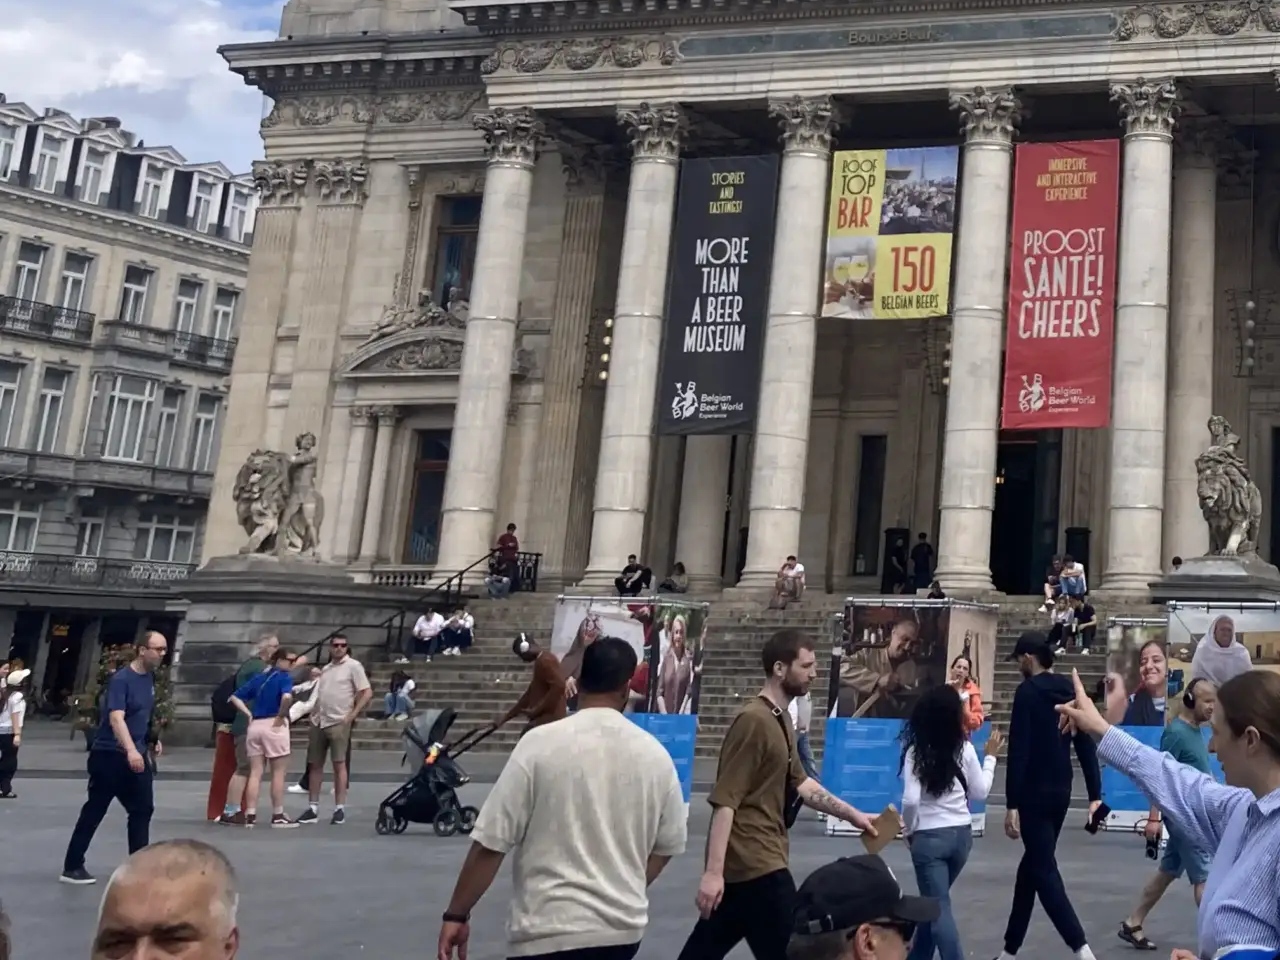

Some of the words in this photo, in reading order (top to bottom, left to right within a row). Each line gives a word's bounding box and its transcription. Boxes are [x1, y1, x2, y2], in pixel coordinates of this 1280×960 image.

[842, 159, 878, 173] ROOF
[1048, 157, 1088, 171] IMMERSIVE
[712, 171, 745, 185] STORIES
[842, 174, 876, 195] TOP
[1037, 174, 1052, 187] AND
[720, 186, 734, 199] AND
[1045, 187, 1088, 201] EXPERIENCE
[837, 196, 873, 229] BAR
[1023, 227, 1106, 255] PROOST
[695, 237, 749, 265] MORE
[891, 245, 936, 292] 150
[1022, 252, 1104, 298] SANTÉ!
[701, 266, 739, 293] THAN
[691, 296, 701, 323] A
[706, 295, 743, 323] BEER
[916, 294, 939, 309] BEERS
[1018, 298, 1102, 339] CHEERS
[683, 324, 746, 352] MUSEUM
[701, 393, 732, 404] Belgian
[1048, 386, 1082, 397] Belgian
[700, 403, 719, 411] Beer
[720, 402, 743, 411] World
[1048, 396, 1069, 405] Beer
[1070, 395, 1096, 404] World
